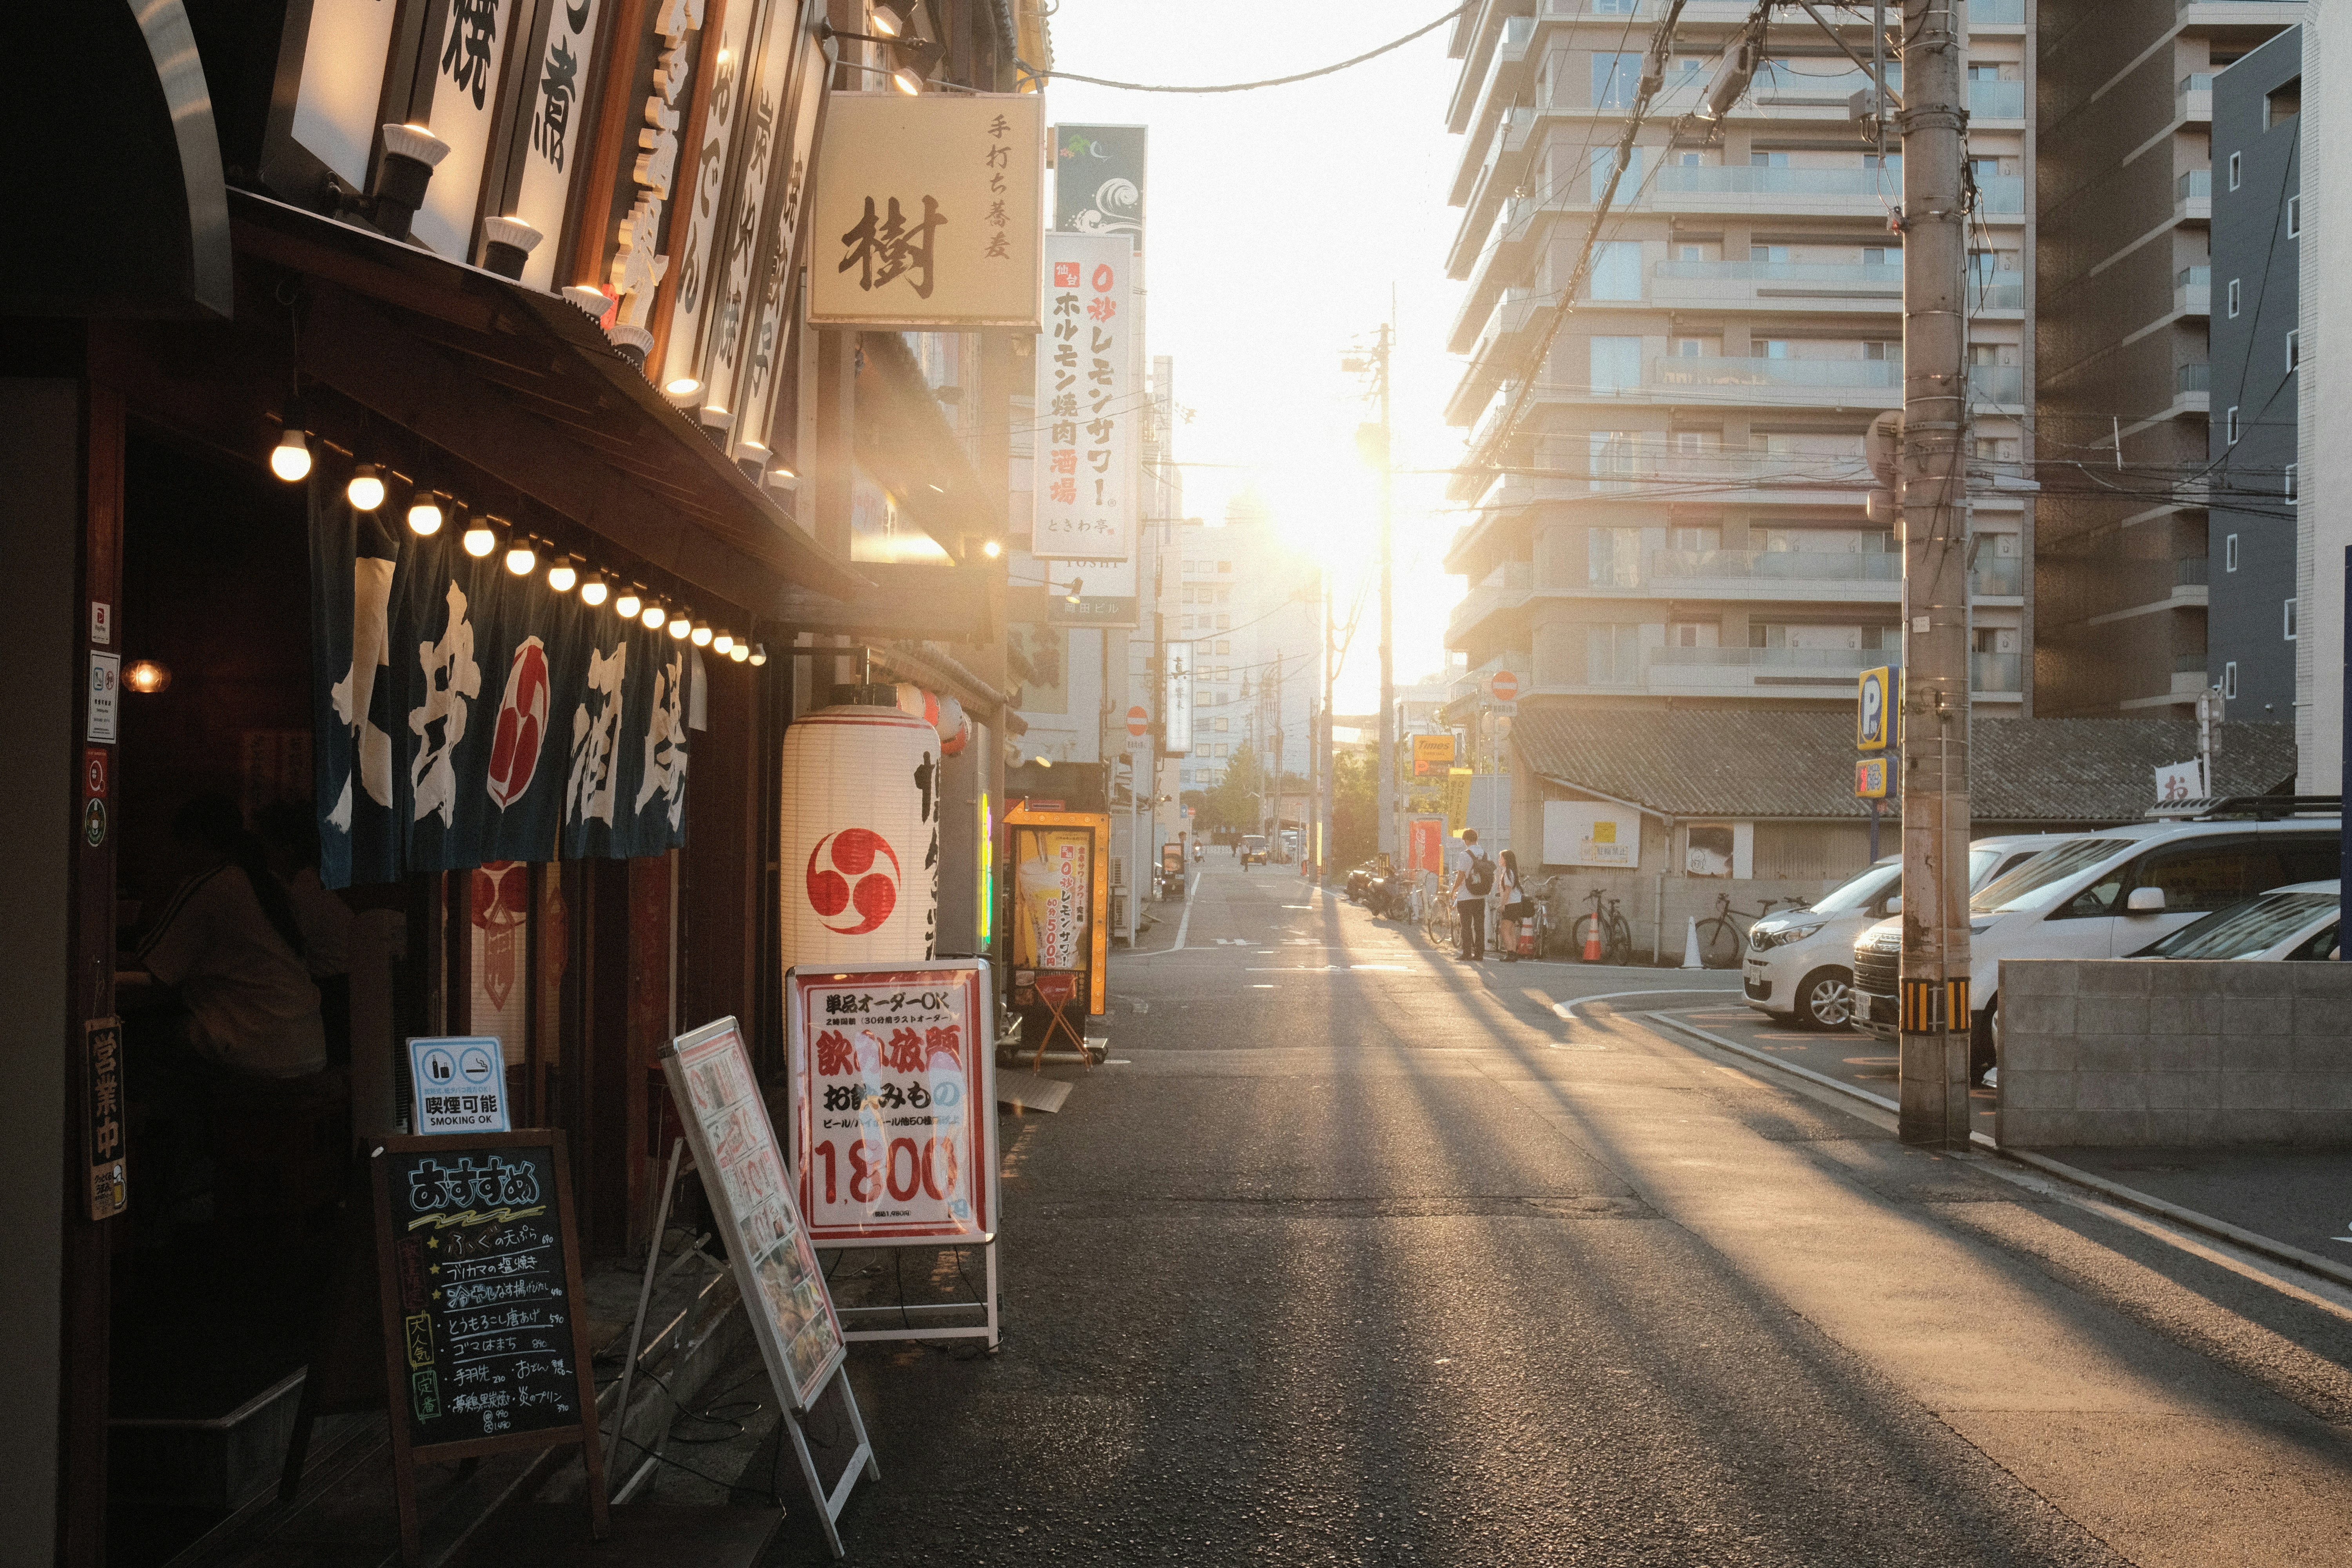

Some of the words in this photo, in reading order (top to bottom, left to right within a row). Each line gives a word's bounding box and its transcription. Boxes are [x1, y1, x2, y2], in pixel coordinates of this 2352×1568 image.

[680, 31, 730, 314] おでん
[984, 114, 1011, 260] 手打ち蕎麦
[838, 194, 948, 299] 樹
[1056, 265, 1077, 286] 仙台
[1050, 292, 1080, 505] ホルモン焼肉酒場
[1049, 519, 1109, 534] ときわ亭
[1065, 603, 1119, 613] 岡田ビル
[1863, 680, 1880, 735] P
[1418, 740, 1450, 750] Times
[1414, 761, 1429, 776] P
[1047, 899, 1058, 966] 60分500円
[826, 992, 950, 1014] 単品オーダーOK
[93, 1031, 118, 1159] 営業中
[425, 1095, 497, 1115] 喫煙可能
[430, 1116, 475, 1126] SMOKING
[478, 1115, 492, 1123] OK
[408, 1156, 539, 1212] おすすめ
[815, 1137, 957, 1205] 1,800
[445, 1224, 537, 1256] ふぐの天ぷら
[447, 1256, 538, 1280] ブリカマの塩焼き
[446, 1279, 549, 1308] 冷やしなす揚げびたし
[449, 1307, 540, 1334] とうもろこし唐あげ
[549, 1314, 564, 1324] 590
[410, 1319, 430, 1362] 大人気
[453, 1337, 517, 1355] ゴマはまち
[453, 1364, 490, 1386] 手羽先
[493, 1375, 506, 1384] 230
[515, 1359, 548, 1379] おでん
[418, 1376, 436, 1412] 定番
[519, 1385, 562, 1407] 炎のプリン
